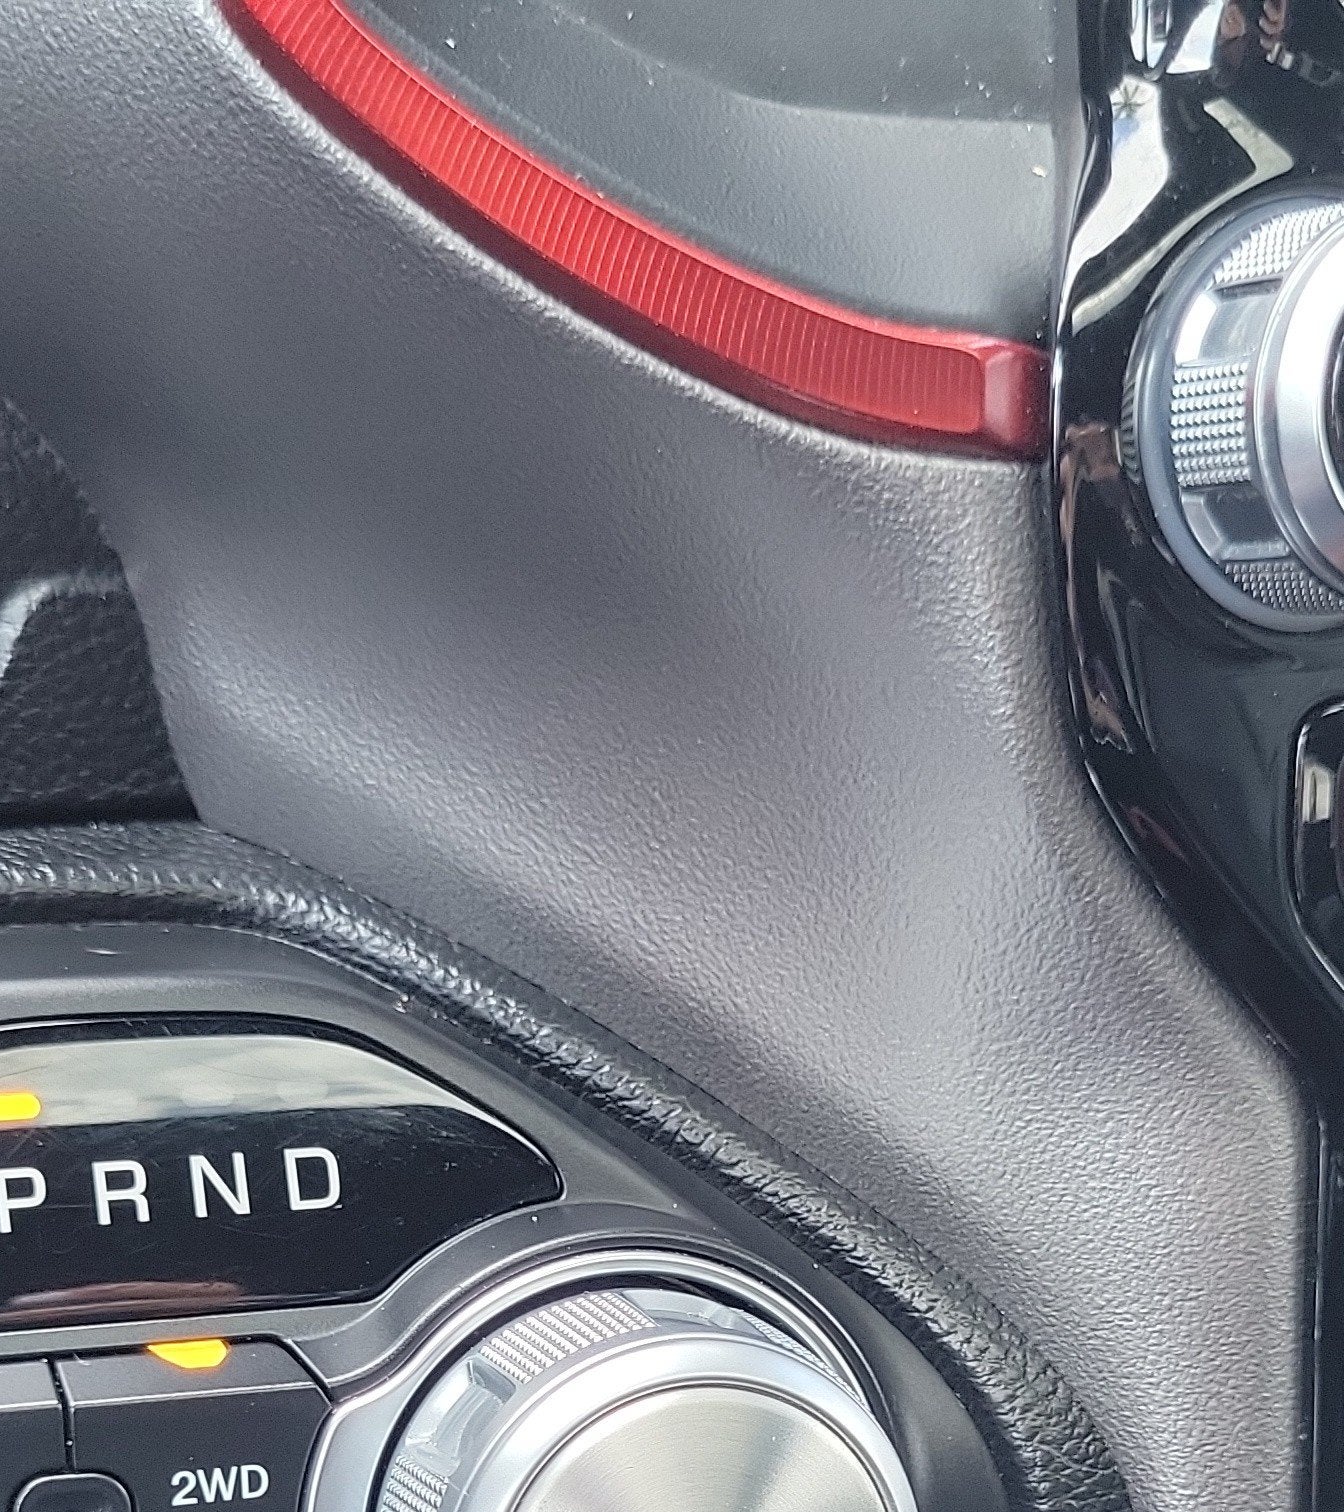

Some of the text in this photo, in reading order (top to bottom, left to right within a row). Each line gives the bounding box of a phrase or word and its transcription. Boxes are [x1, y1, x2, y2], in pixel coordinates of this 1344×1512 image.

[92, 1160, 151, 1227] R
[189, 1151, 252, 1219] N
[283, 1145, 342, 1212] D
[170, 1464, 269, 1507] 2WD
